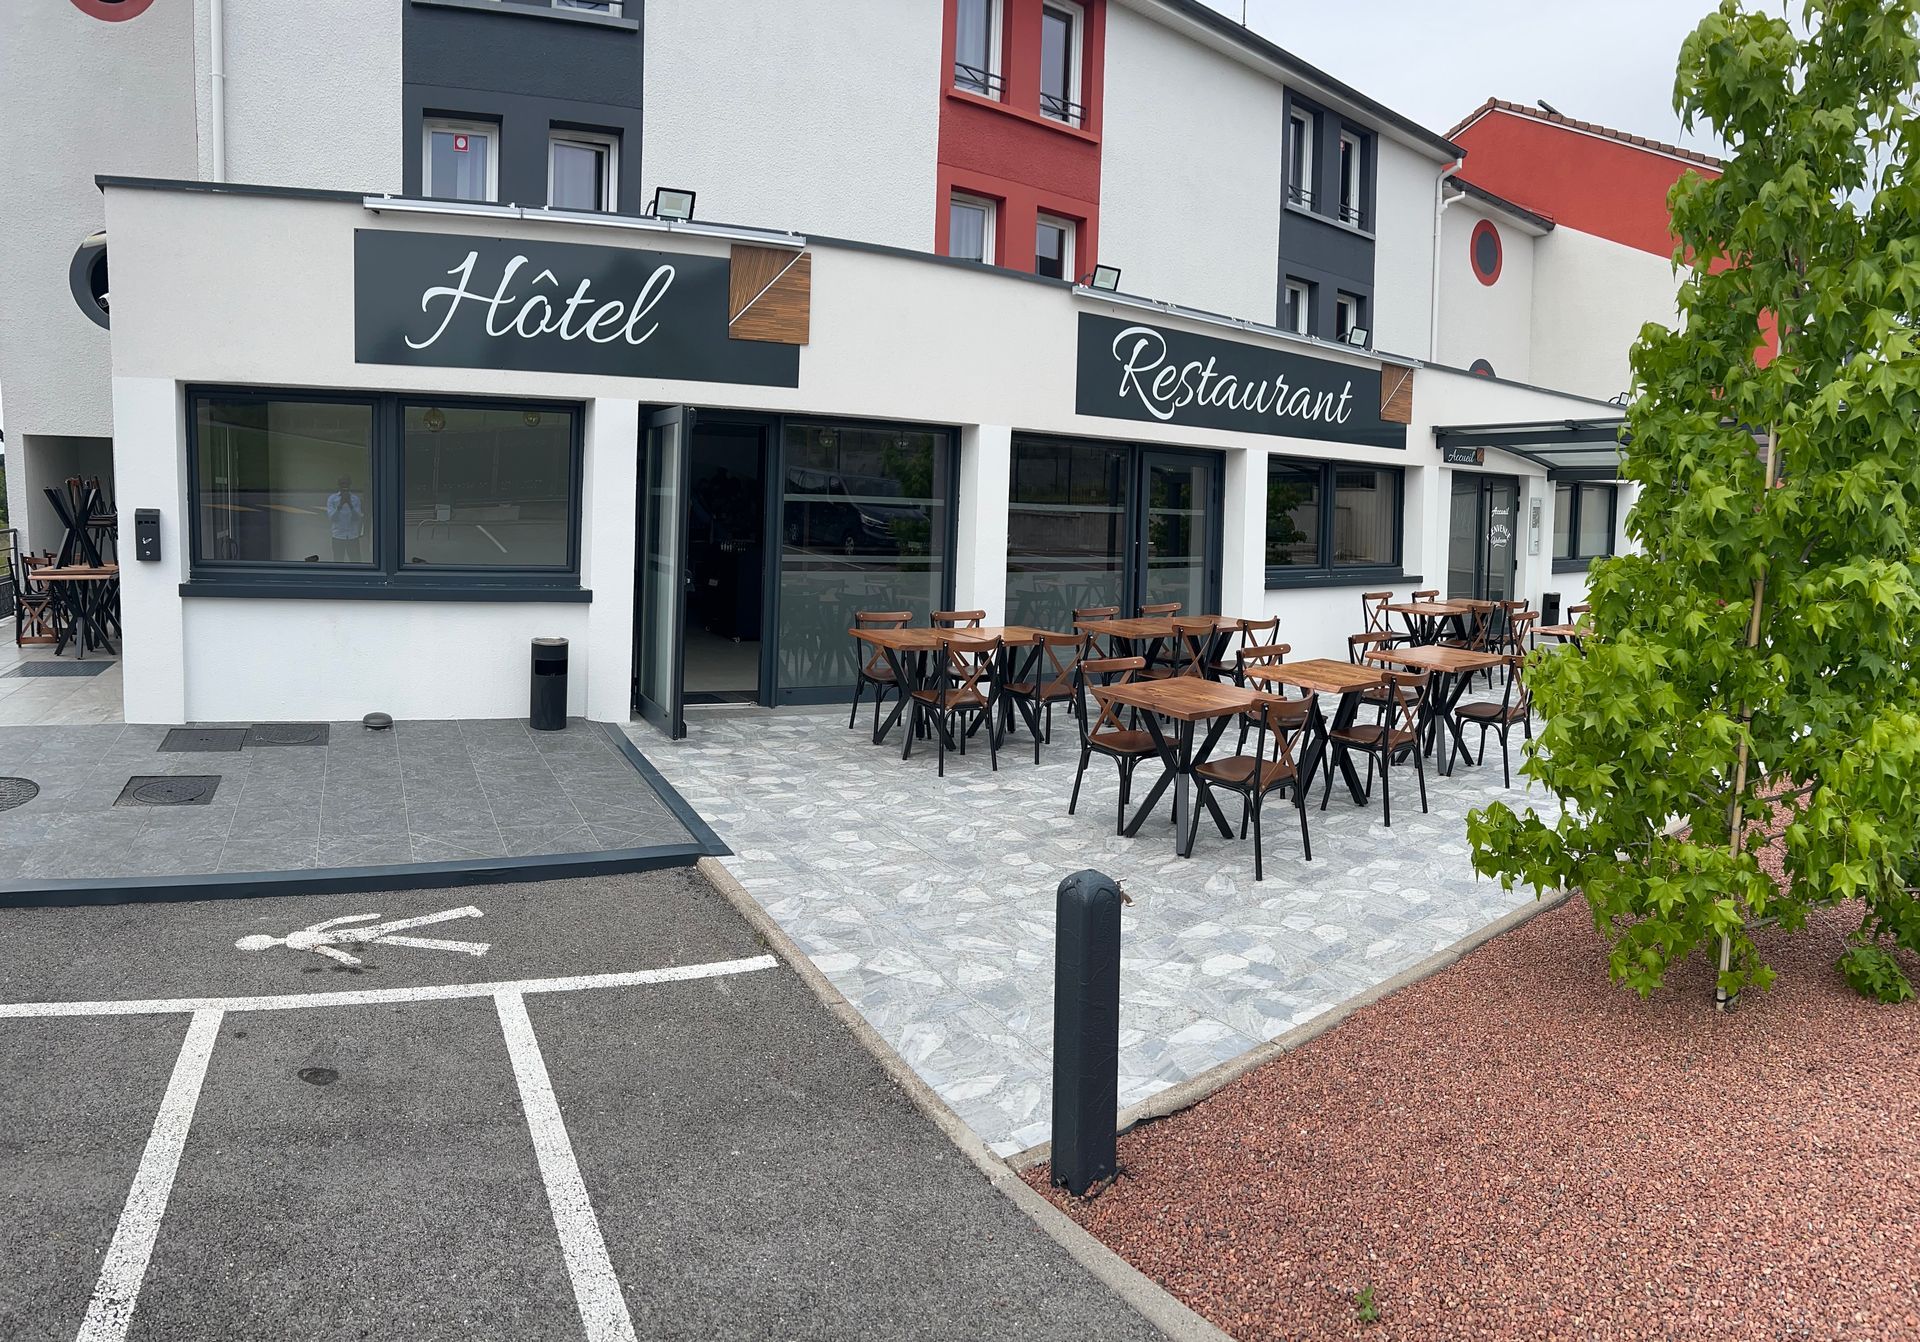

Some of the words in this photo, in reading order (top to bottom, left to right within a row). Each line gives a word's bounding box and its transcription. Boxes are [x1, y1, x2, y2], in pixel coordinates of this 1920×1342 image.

[404, 250, 676, 349] Hôtel
[1112, 326, 1353, 424] Restaurant
[1448, 449, 1475, 462] Accueil
